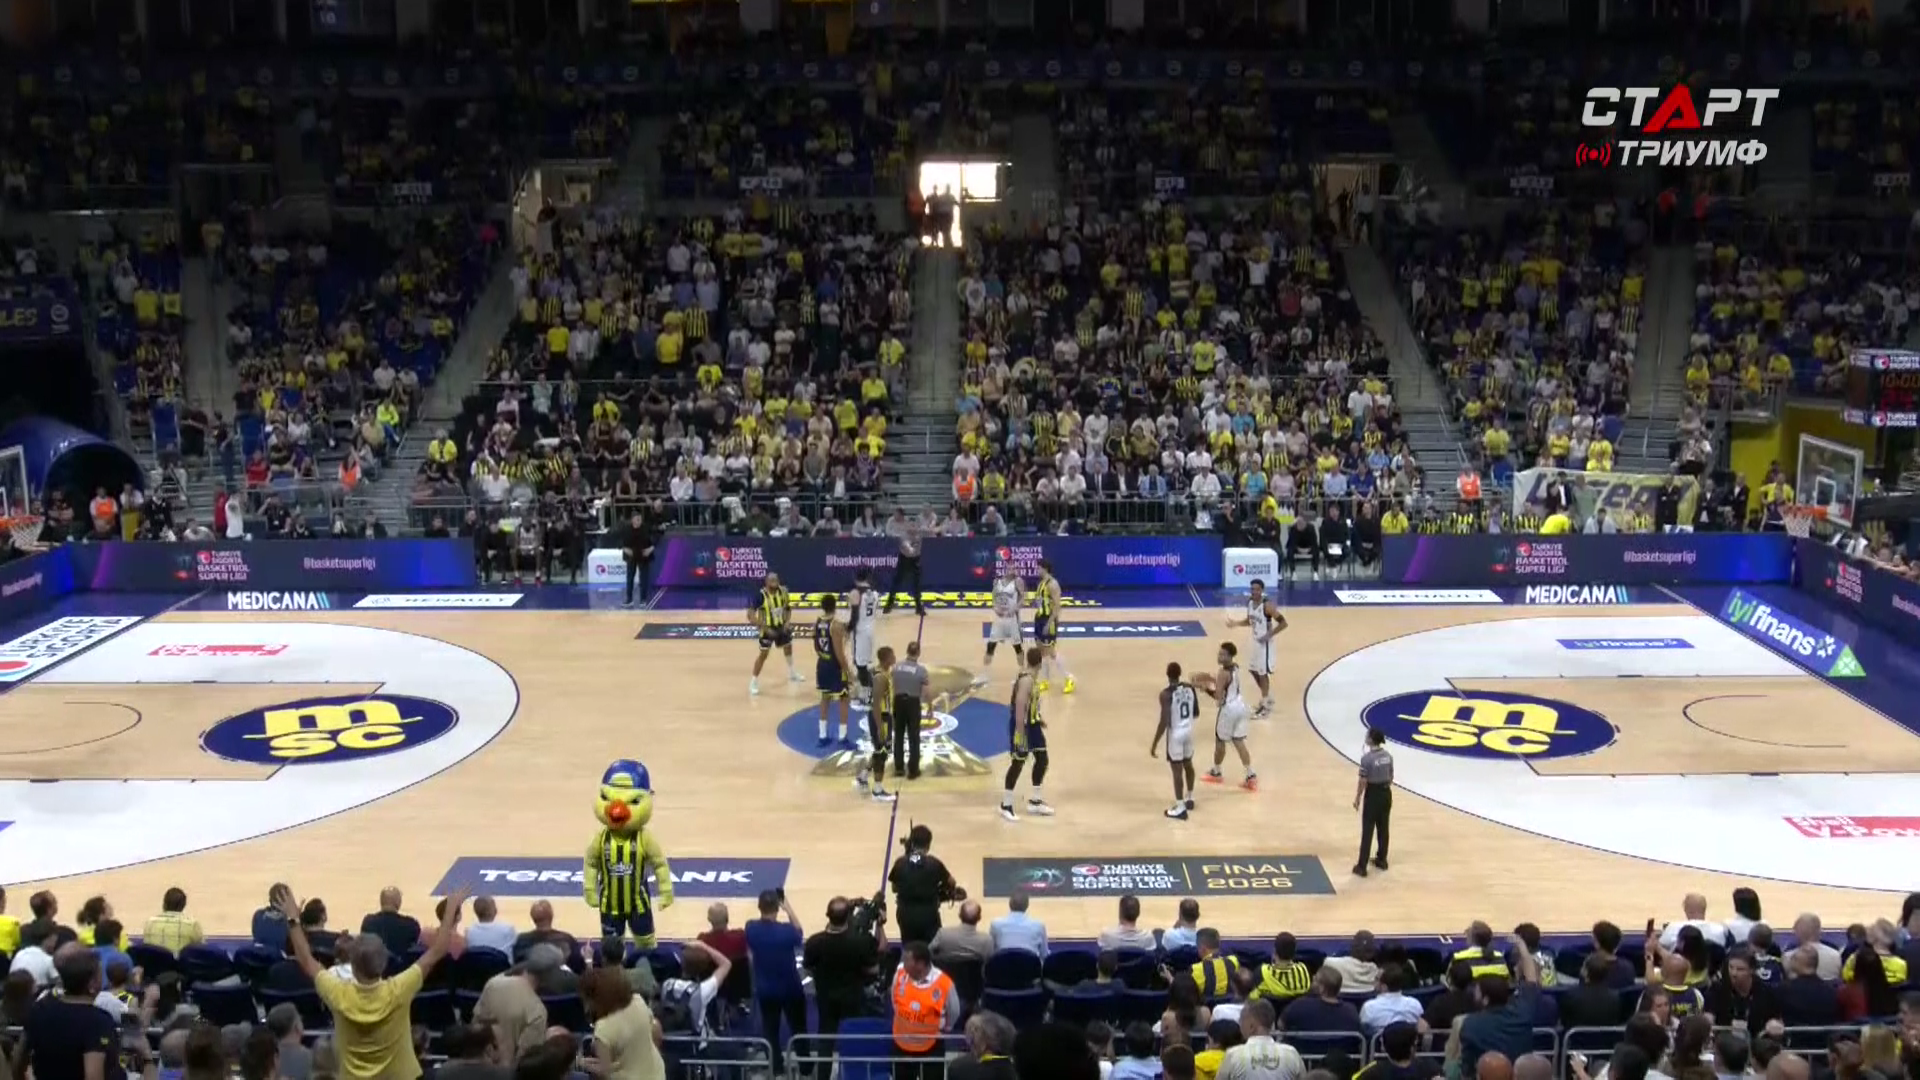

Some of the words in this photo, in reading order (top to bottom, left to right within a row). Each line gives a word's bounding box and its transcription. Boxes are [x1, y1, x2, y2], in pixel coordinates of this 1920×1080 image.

[228, 591, 319, 609] MEDICANA
[1526, 585, 1616, 603] MEDICANA
[1180, 702, 1190, 719] 0
[1207, 877, 1293, 889] 2026
